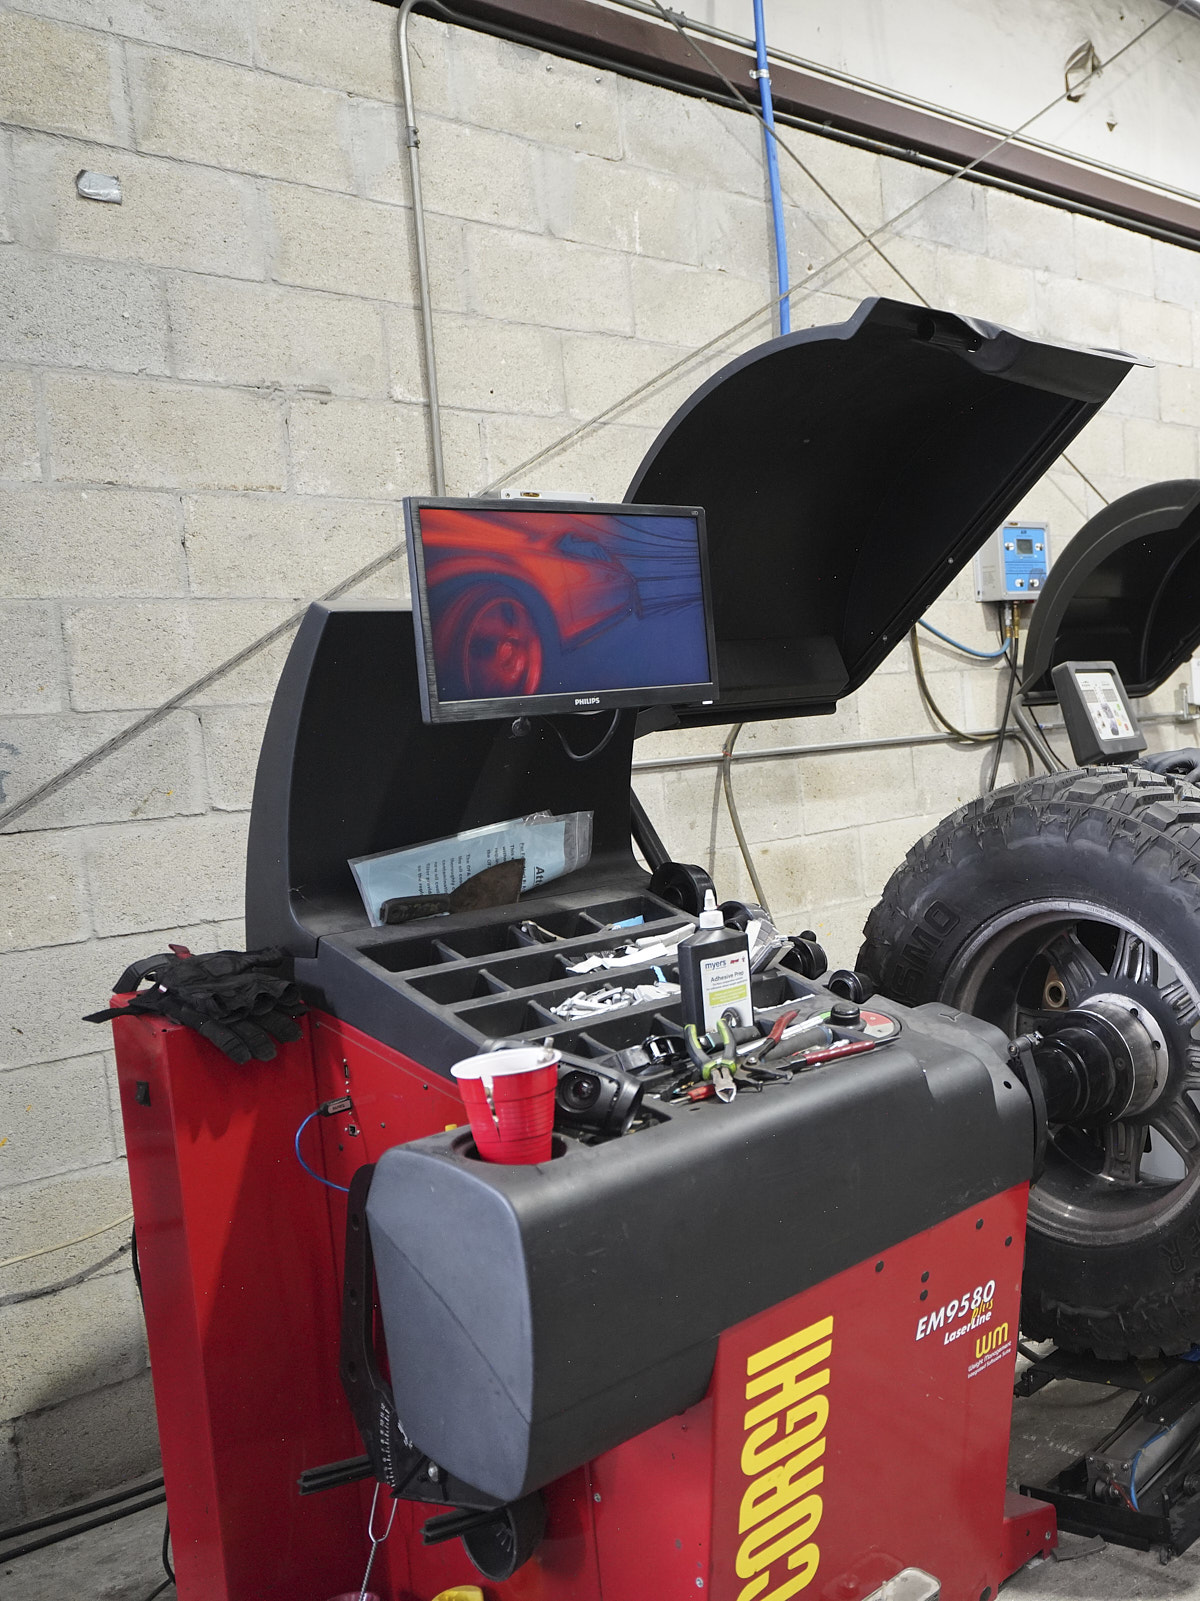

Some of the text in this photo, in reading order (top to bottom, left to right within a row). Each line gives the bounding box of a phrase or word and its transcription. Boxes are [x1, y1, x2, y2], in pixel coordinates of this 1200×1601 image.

[575, 697, 600, 706] PHILIPS
[704, 960, 727, 970] myers
[711, 973, 734, 983] Adhesive
[915, 1279, 996, 1341] EM9580
[943, 1311, 992, 1346] LaserLine
[735, 1315, 834, 1601] CORGHI
